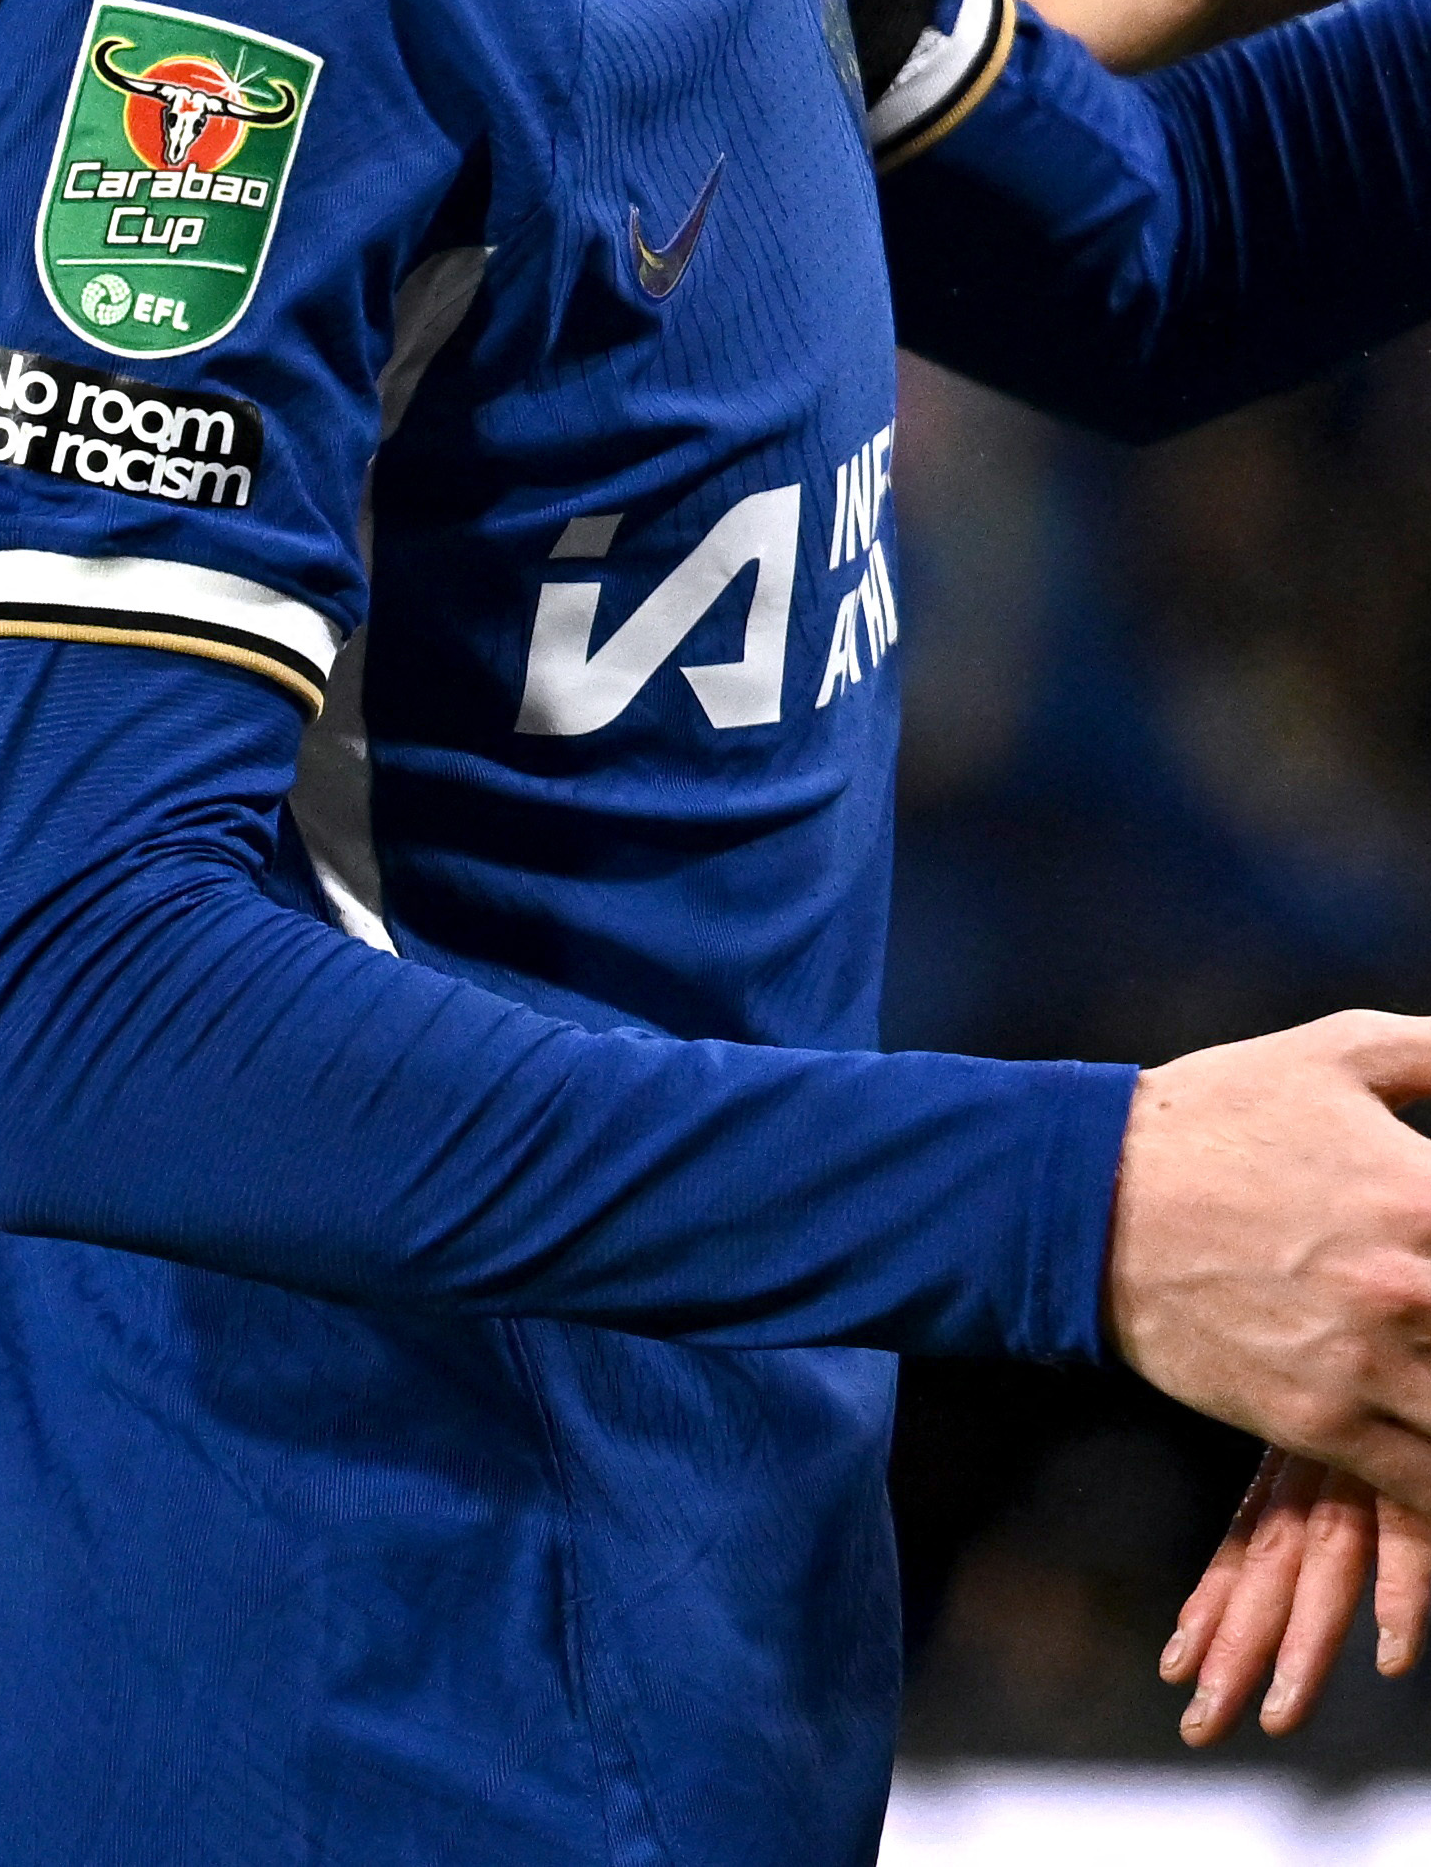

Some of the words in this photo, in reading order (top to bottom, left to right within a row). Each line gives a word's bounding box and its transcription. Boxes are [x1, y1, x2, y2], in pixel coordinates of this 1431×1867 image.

[63, 162, 270, 209] Carabao
[106, 206, 205, 254] Cup
[132, 293, 190, 332] EFL
[67, 381, 235, 455] room
[51, 431, 252, 507] racism
